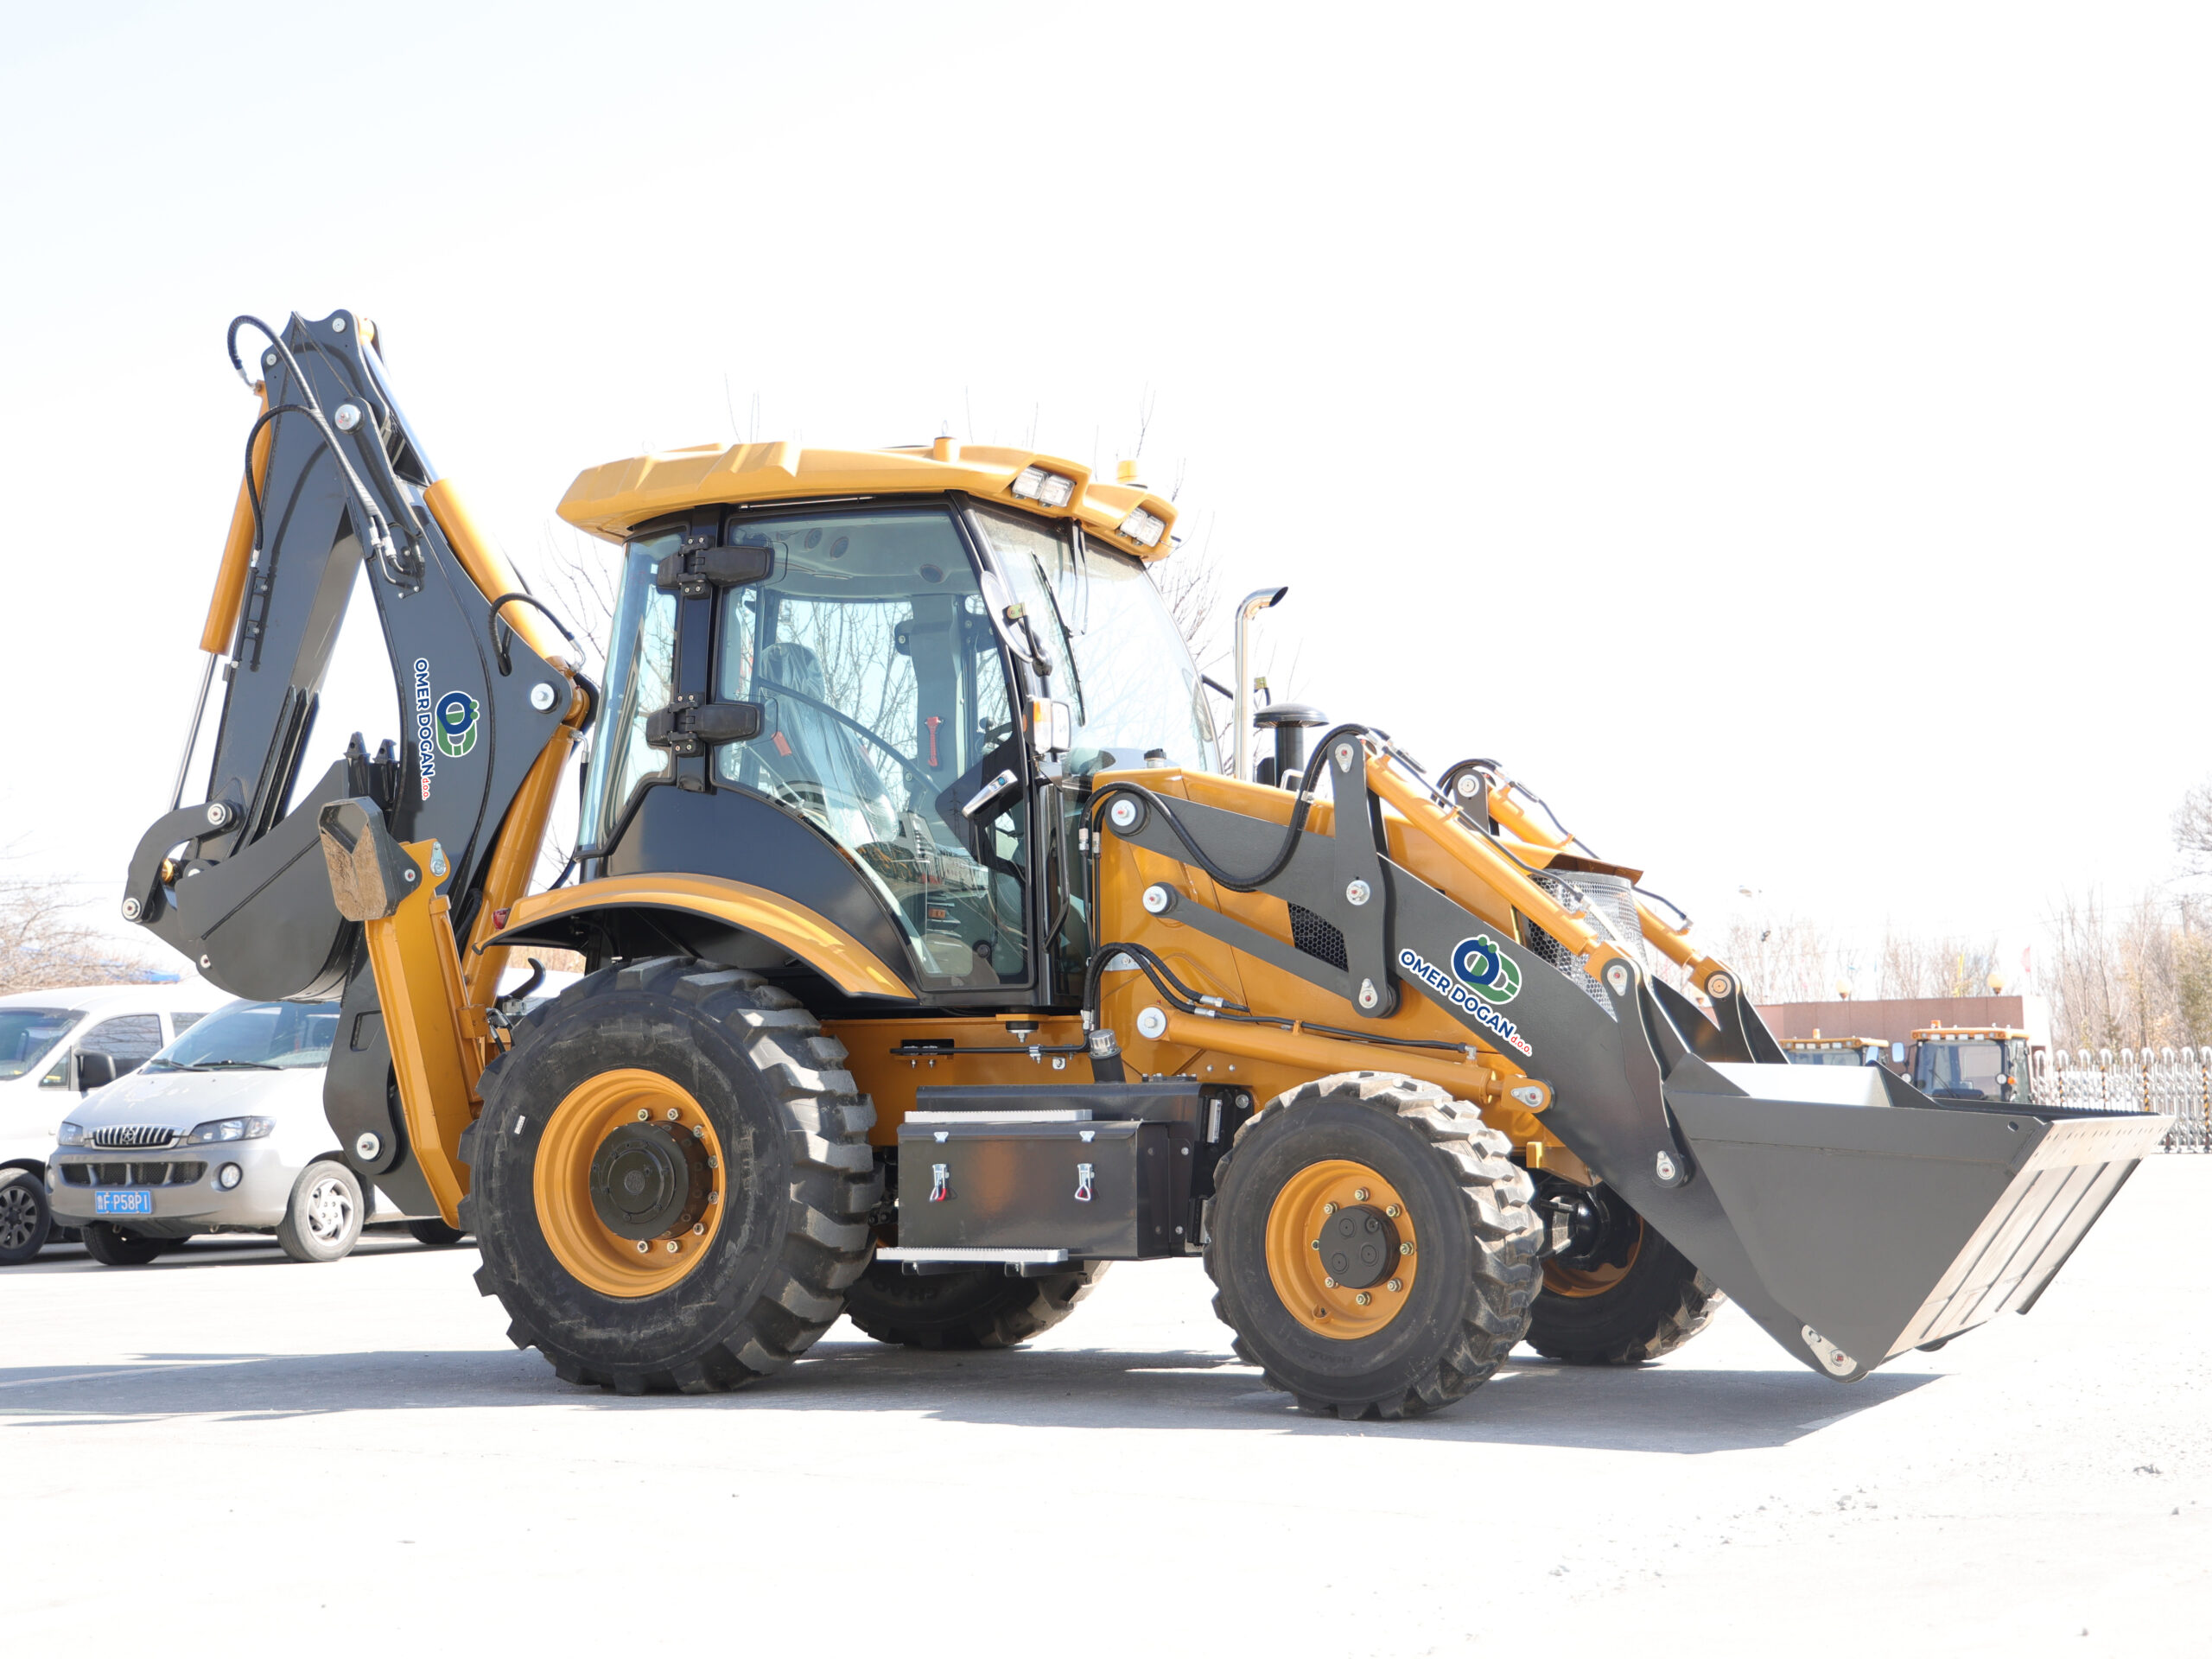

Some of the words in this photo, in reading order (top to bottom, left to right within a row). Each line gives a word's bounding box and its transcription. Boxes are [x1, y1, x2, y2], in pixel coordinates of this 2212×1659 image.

[415, 658, 430, 711] OMER
[417, 714, 435, 777] DOGAN
[422, 778, 430, 800] d.o.o.
[1400, 950, 1452, 994] OMER
[1451, 986, 1515, 1039] DOGAN
[1510, 1035, 1531, 1055] d.o.o.
